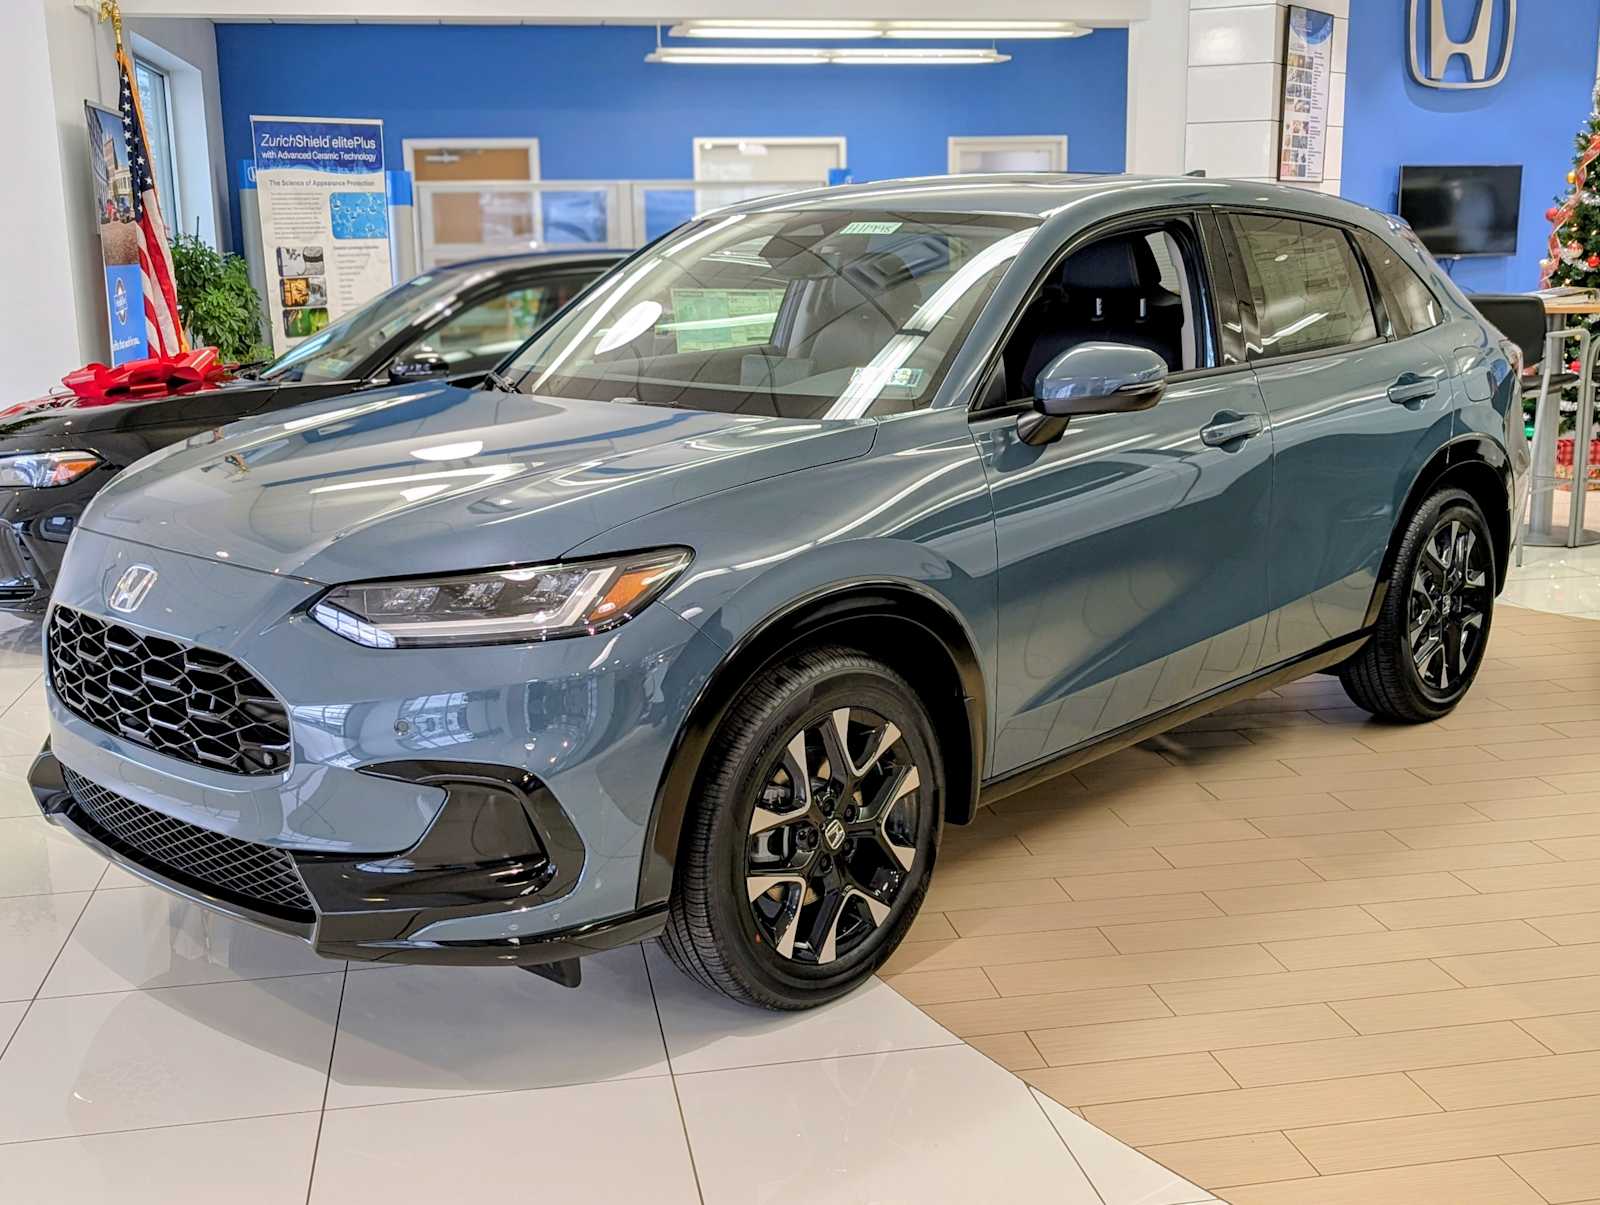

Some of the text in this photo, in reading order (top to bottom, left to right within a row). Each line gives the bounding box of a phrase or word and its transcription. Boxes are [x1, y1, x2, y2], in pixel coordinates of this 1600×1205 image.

[332, 136, 376, 149] elitePlus
[261, 150, 376, 162] with Advanced Ceramic Technology
[269, 179, 280, 187] The
[281, 179, 304, 187] Science
[305, 179, 312, 187] of
[313, 179, 345, 188] Appearance
